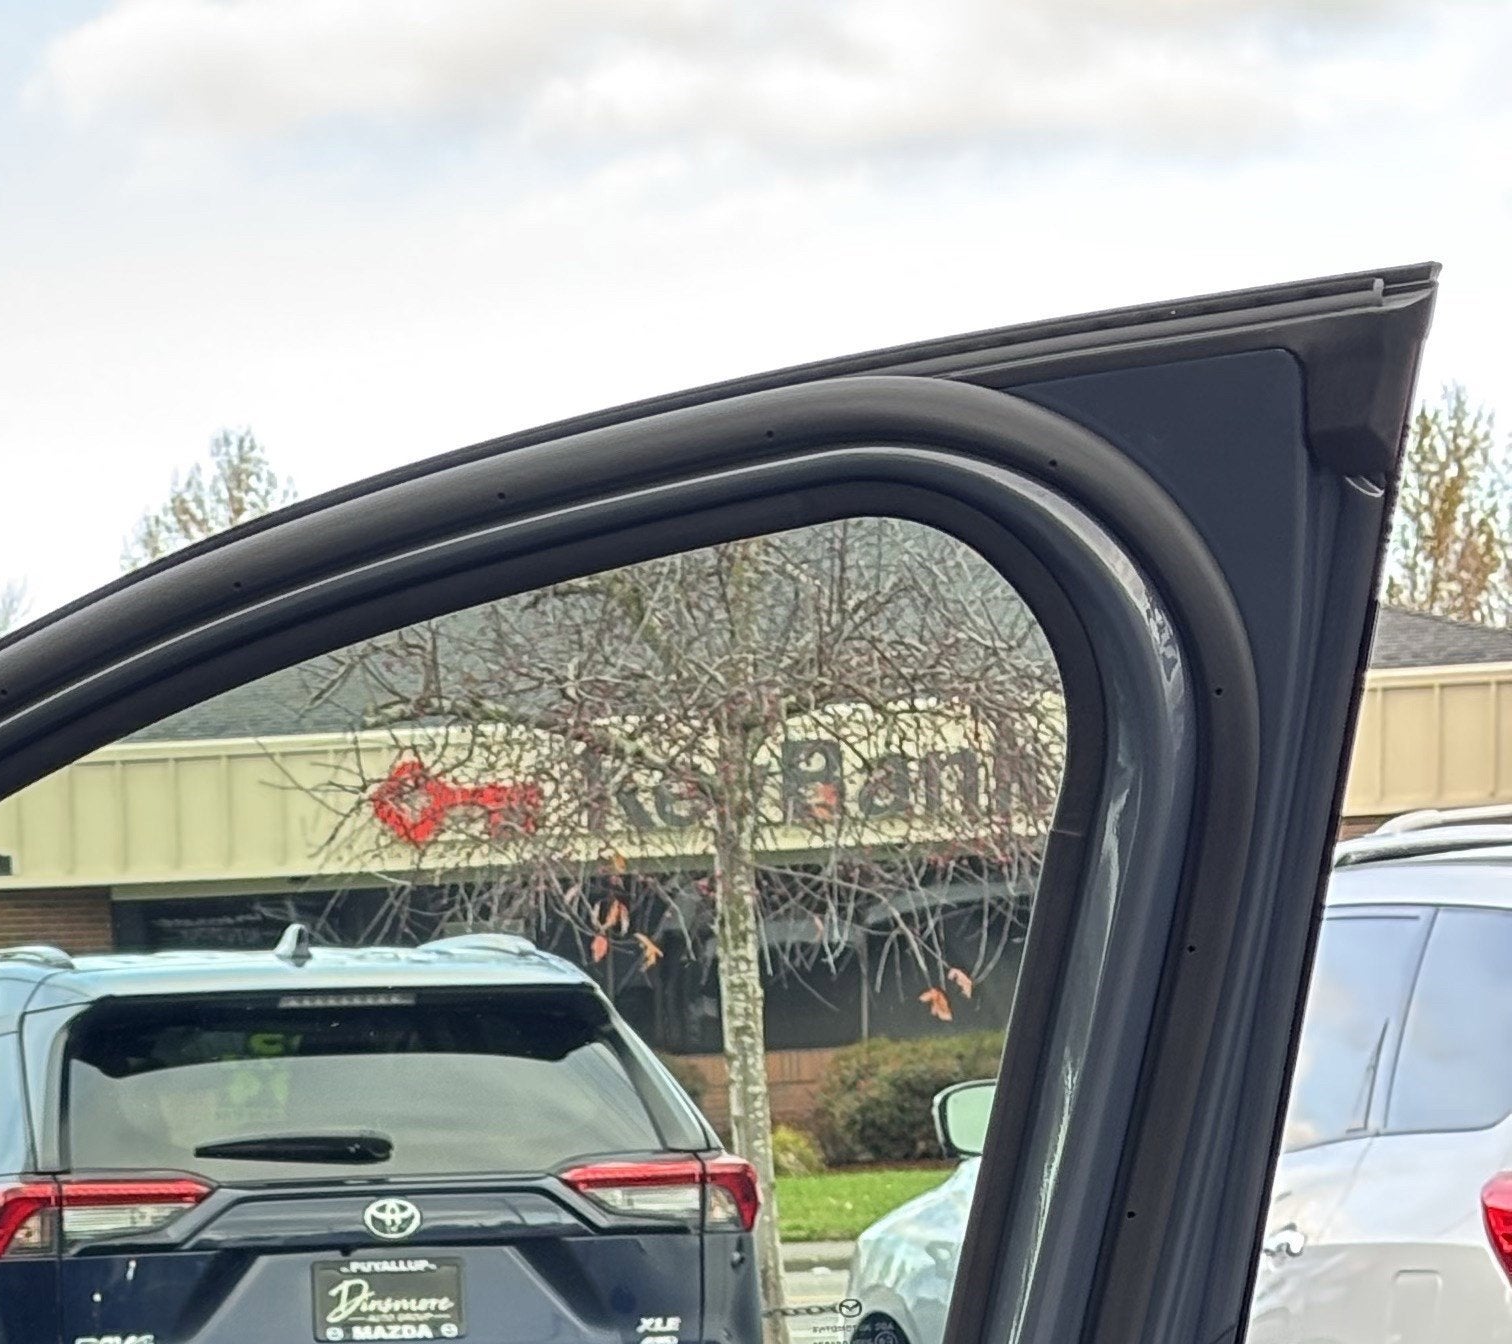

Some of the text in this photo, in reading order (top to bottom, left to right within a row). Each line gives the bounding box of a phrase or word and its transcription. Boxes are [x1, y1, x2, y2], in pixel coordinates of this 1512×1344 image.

[349, 1259, 429, 1273] PUYALLUP
[351, 1323, 434, 1340] MAZDA
[636, 1316, 681, 1333] XLE
